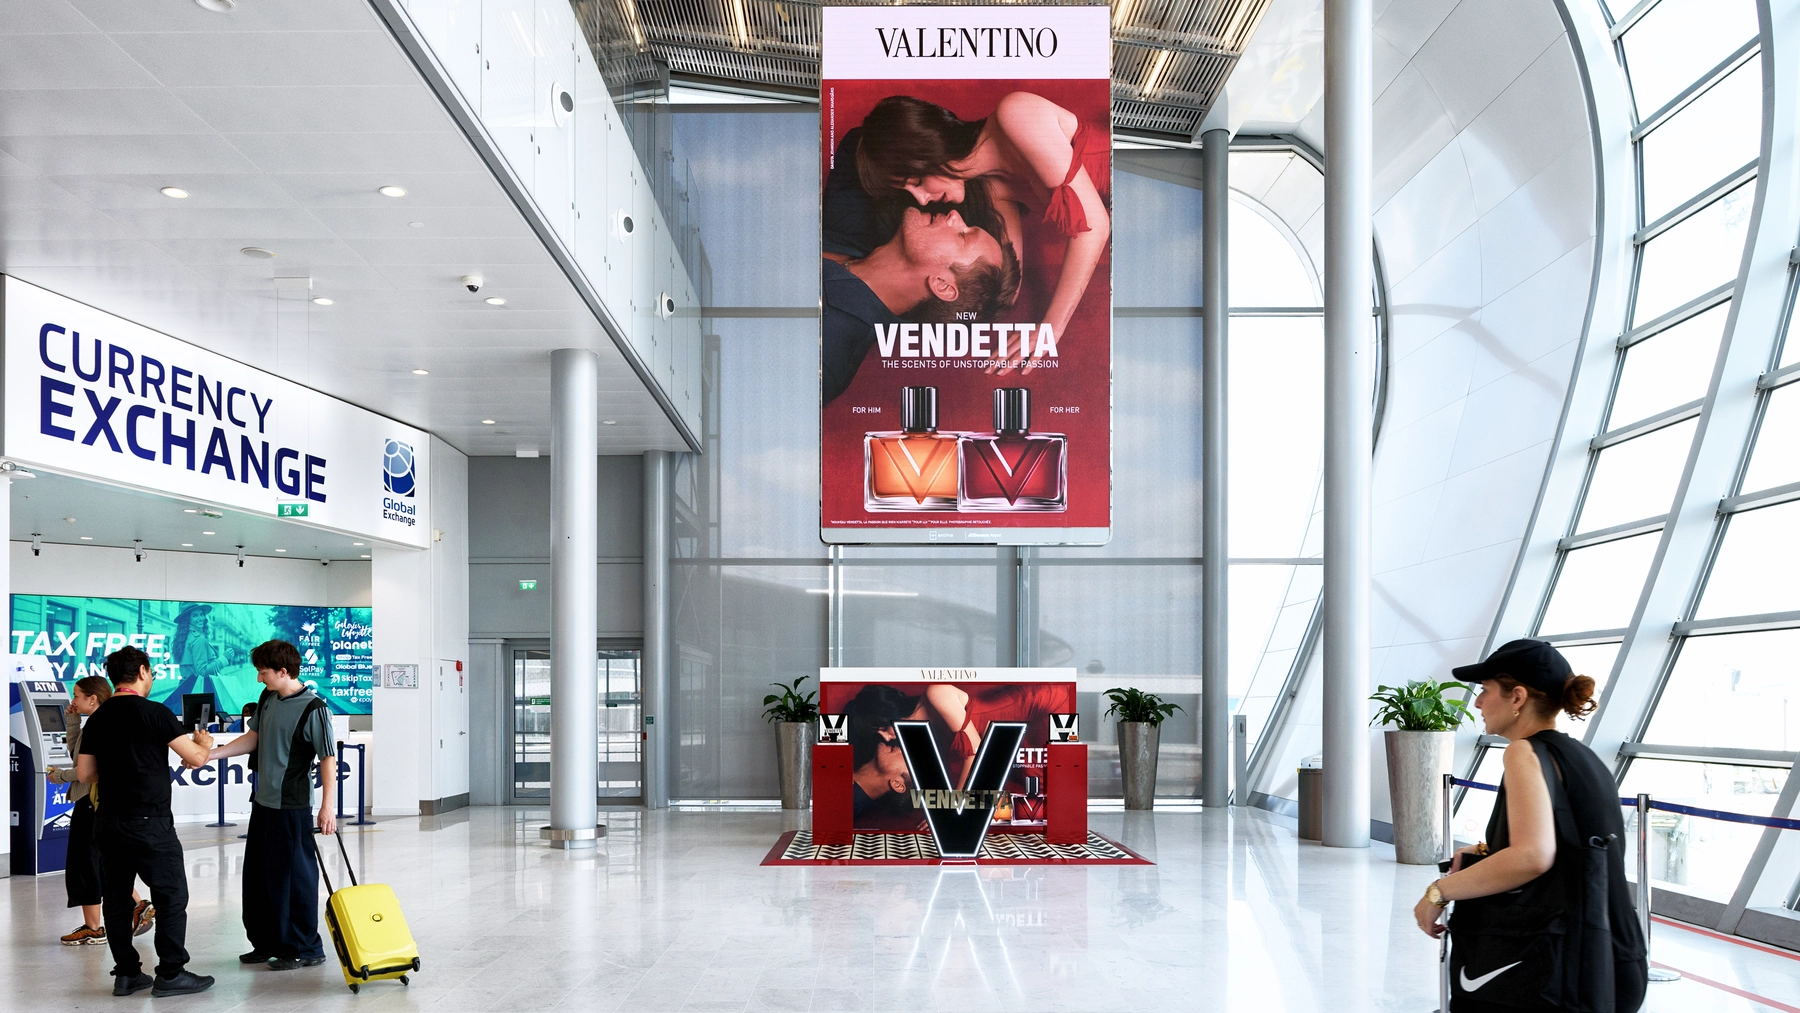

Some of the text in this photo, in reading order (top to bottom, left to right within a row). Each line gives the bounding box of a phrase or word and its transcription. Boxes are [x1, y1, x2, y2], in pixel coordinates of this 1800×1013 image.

[875, 27, 1058, 58] VALENTINO
[956, 312, 977, 320] NEW
[874, 323, 1058, 357] VENDETTA
[882, 360, 1059, 368] THE SCENTS OF UNSTOPPABLE PASSION
[39, 323, 273, 434] CURRENCY
[40, 375, 327, 503] EXCHANGE
[383, 497, 416, 516] Global
[383, 509, 416, 527] Exchange
[12, 631, 80, 657] TAX
[333, 640, 373, 651] planet
[73, 663, 109, 680] AN
[300, 666, 325, 674] SolPay
[920, 669, 978, 681] VALENTINO
[34, 682, 59, 692] ATM
[342, 674, 373, 684] SkipTax
[332, 686, 373, 697] taxfree
[890, 720, 1029, 858] V
[52, 793, 72, 805] AT
[910, 789, 1013, 810] VENDETTA
